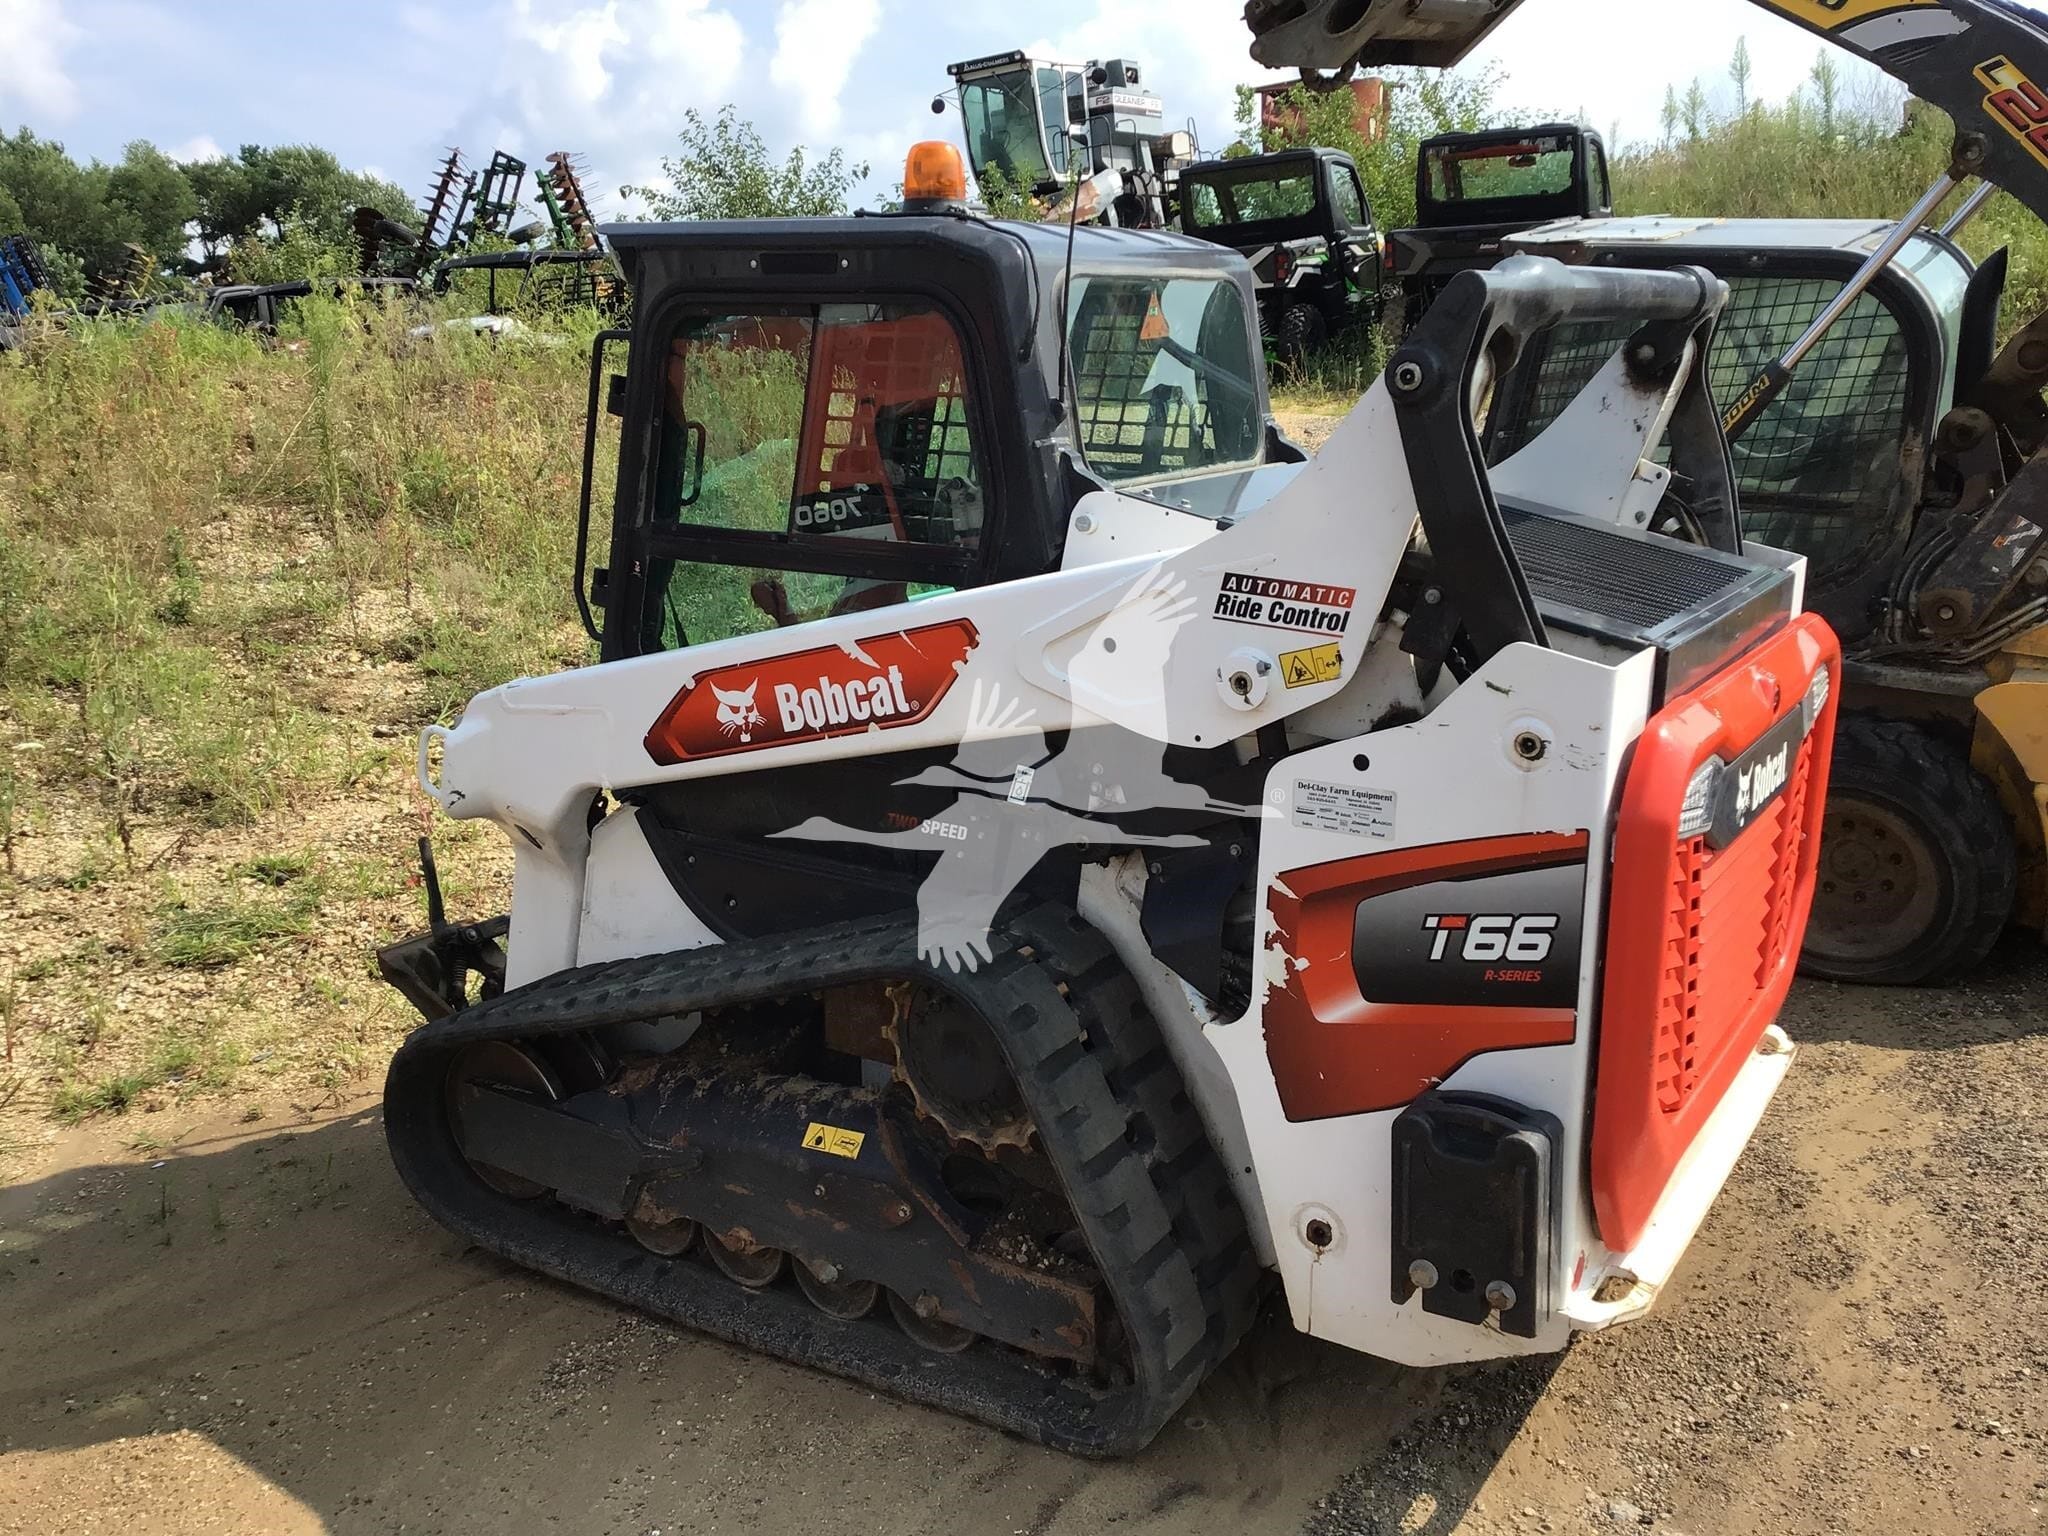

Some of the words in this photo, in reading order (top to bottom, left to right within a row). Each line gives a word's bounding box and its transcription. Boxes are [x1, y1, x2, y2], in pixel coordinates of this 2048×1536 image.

[1095, 95, 1110, 106] F2
[1225, 576, 1350, 606] AUTOMATIC
[1214, 593, 1263, 620] Ride
[1268, 600, 1350, 633] Control
[774, 664, 911, 733] Bobcat
[1297, 781, 1328, 795] Del-Clay
[1329, 786, 1350, 796] Farm
[1351, 789, 1393, 802] Equipment
[1751, 741, 1788, 812] Bobcat
[887, 812, 918, 828] TWO
[920, 819, 969, 841] SPEED
[1424, 914, 1559, 962] T66
[1483, 969, 1542, 982] R-SERIES
